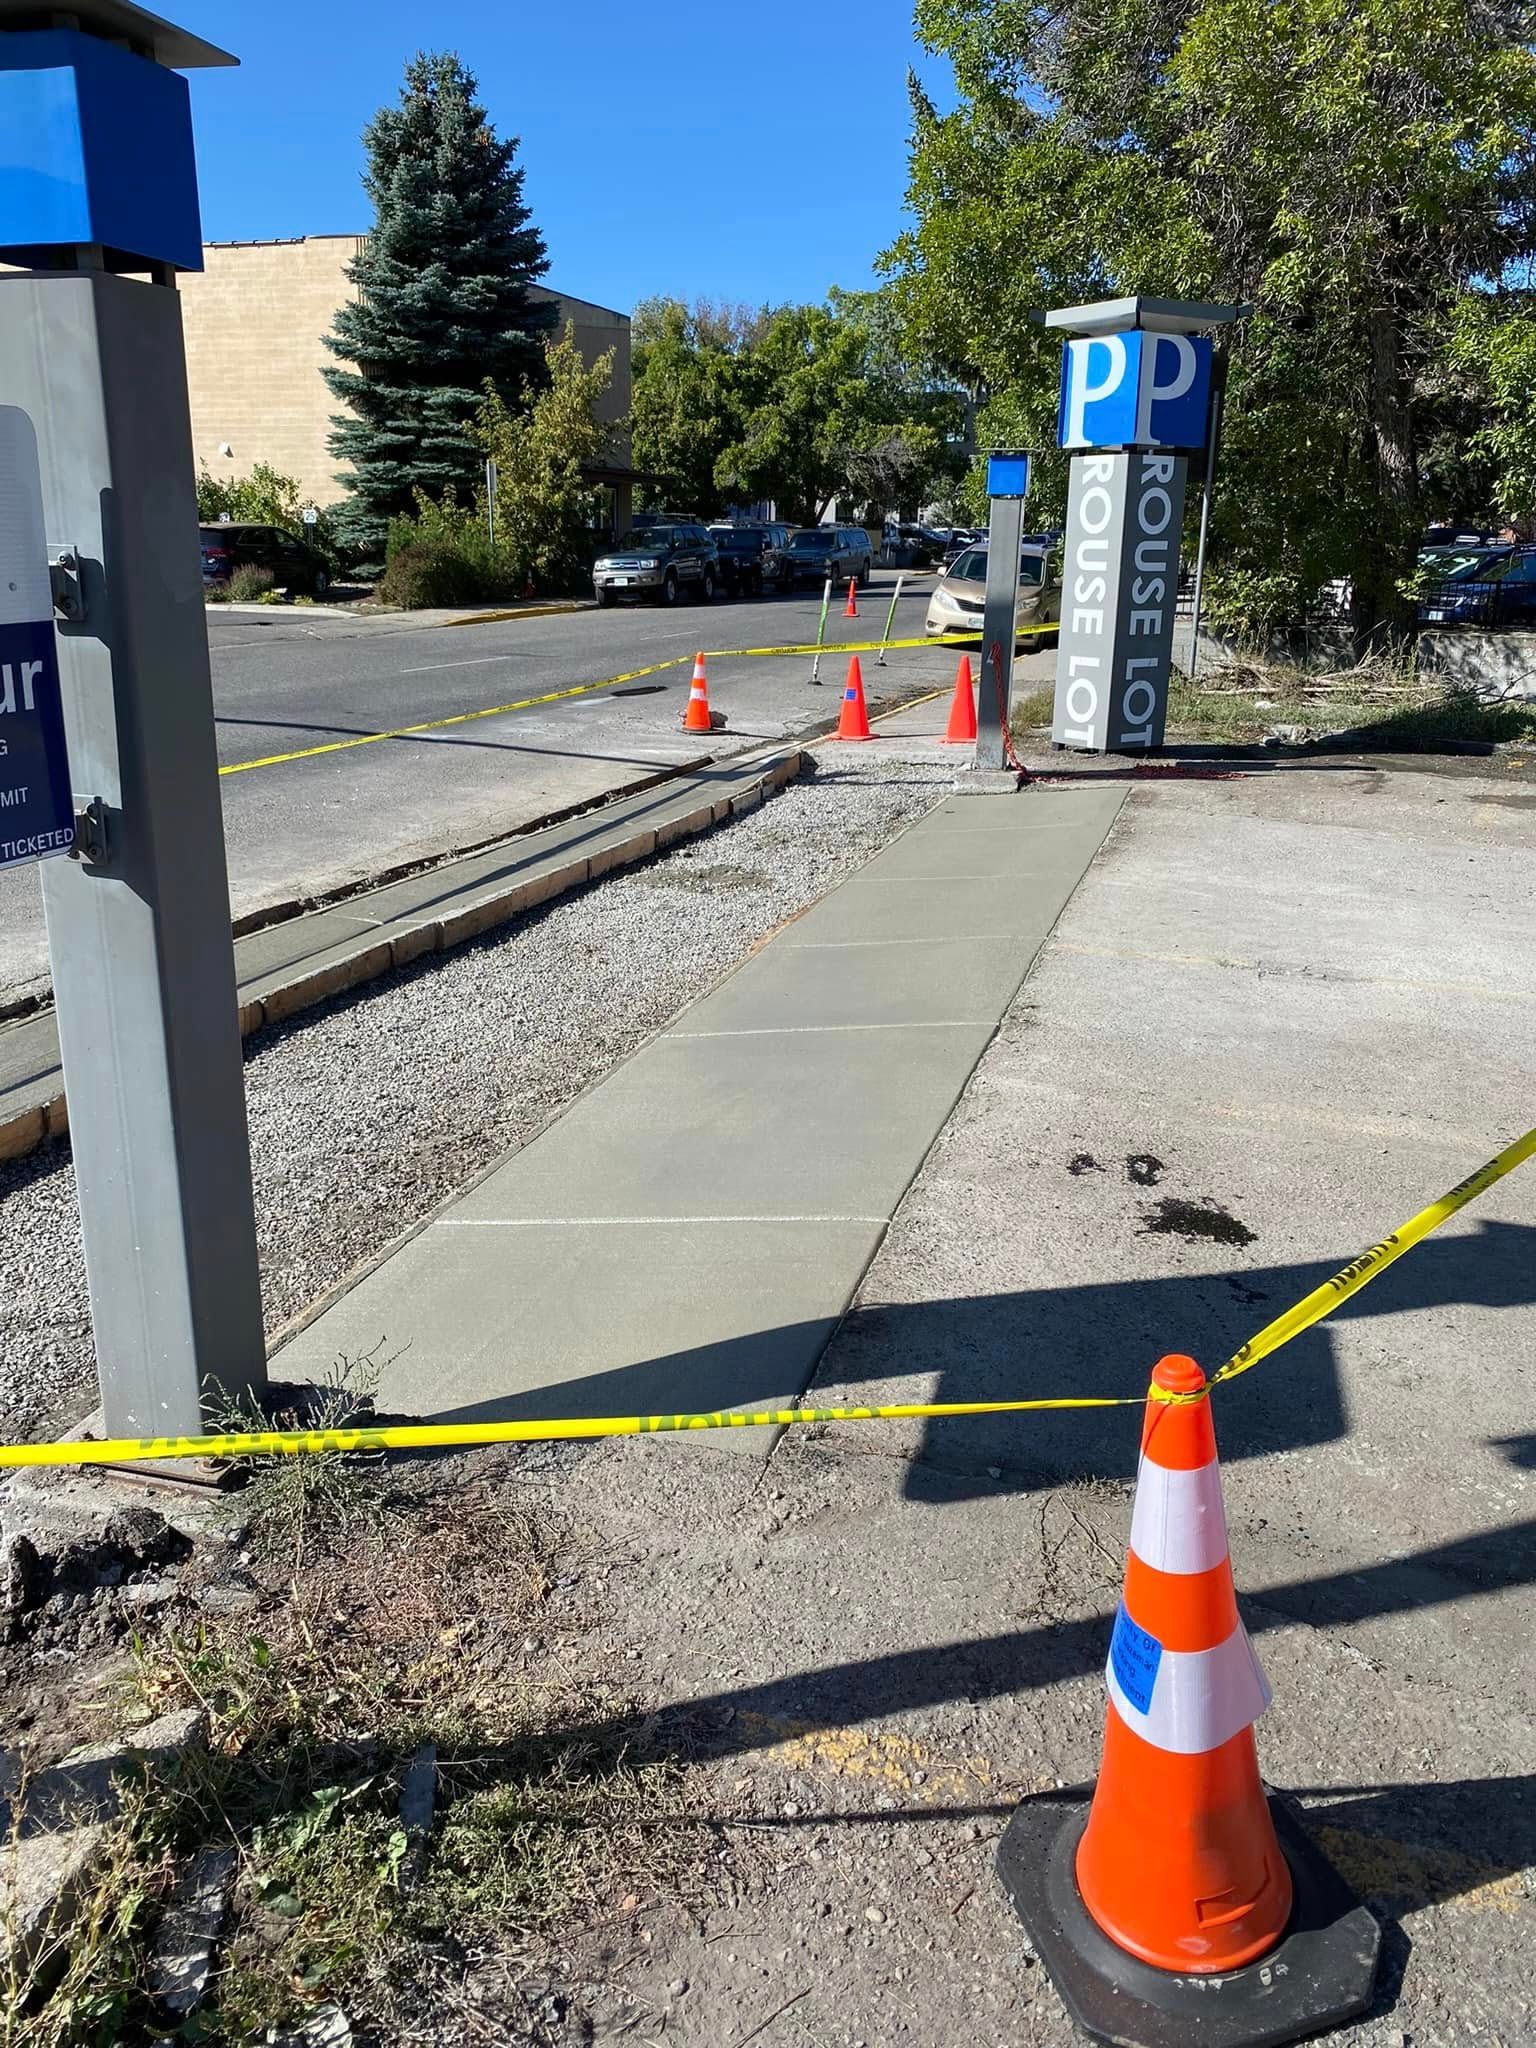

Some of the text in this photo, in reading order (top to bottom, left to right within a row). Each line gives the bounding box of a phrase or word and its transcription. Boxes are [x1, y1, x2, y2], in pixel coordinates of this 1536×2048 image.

[1063, 336, 1126, 448] P
[1135, 330, 1196, 445] P
[1064, 455, 1114, 749] ROUSE LOT
[1120, 455, 1175, 747] ROUSE LOT
[1, 828, 74, 859] TICKETED
